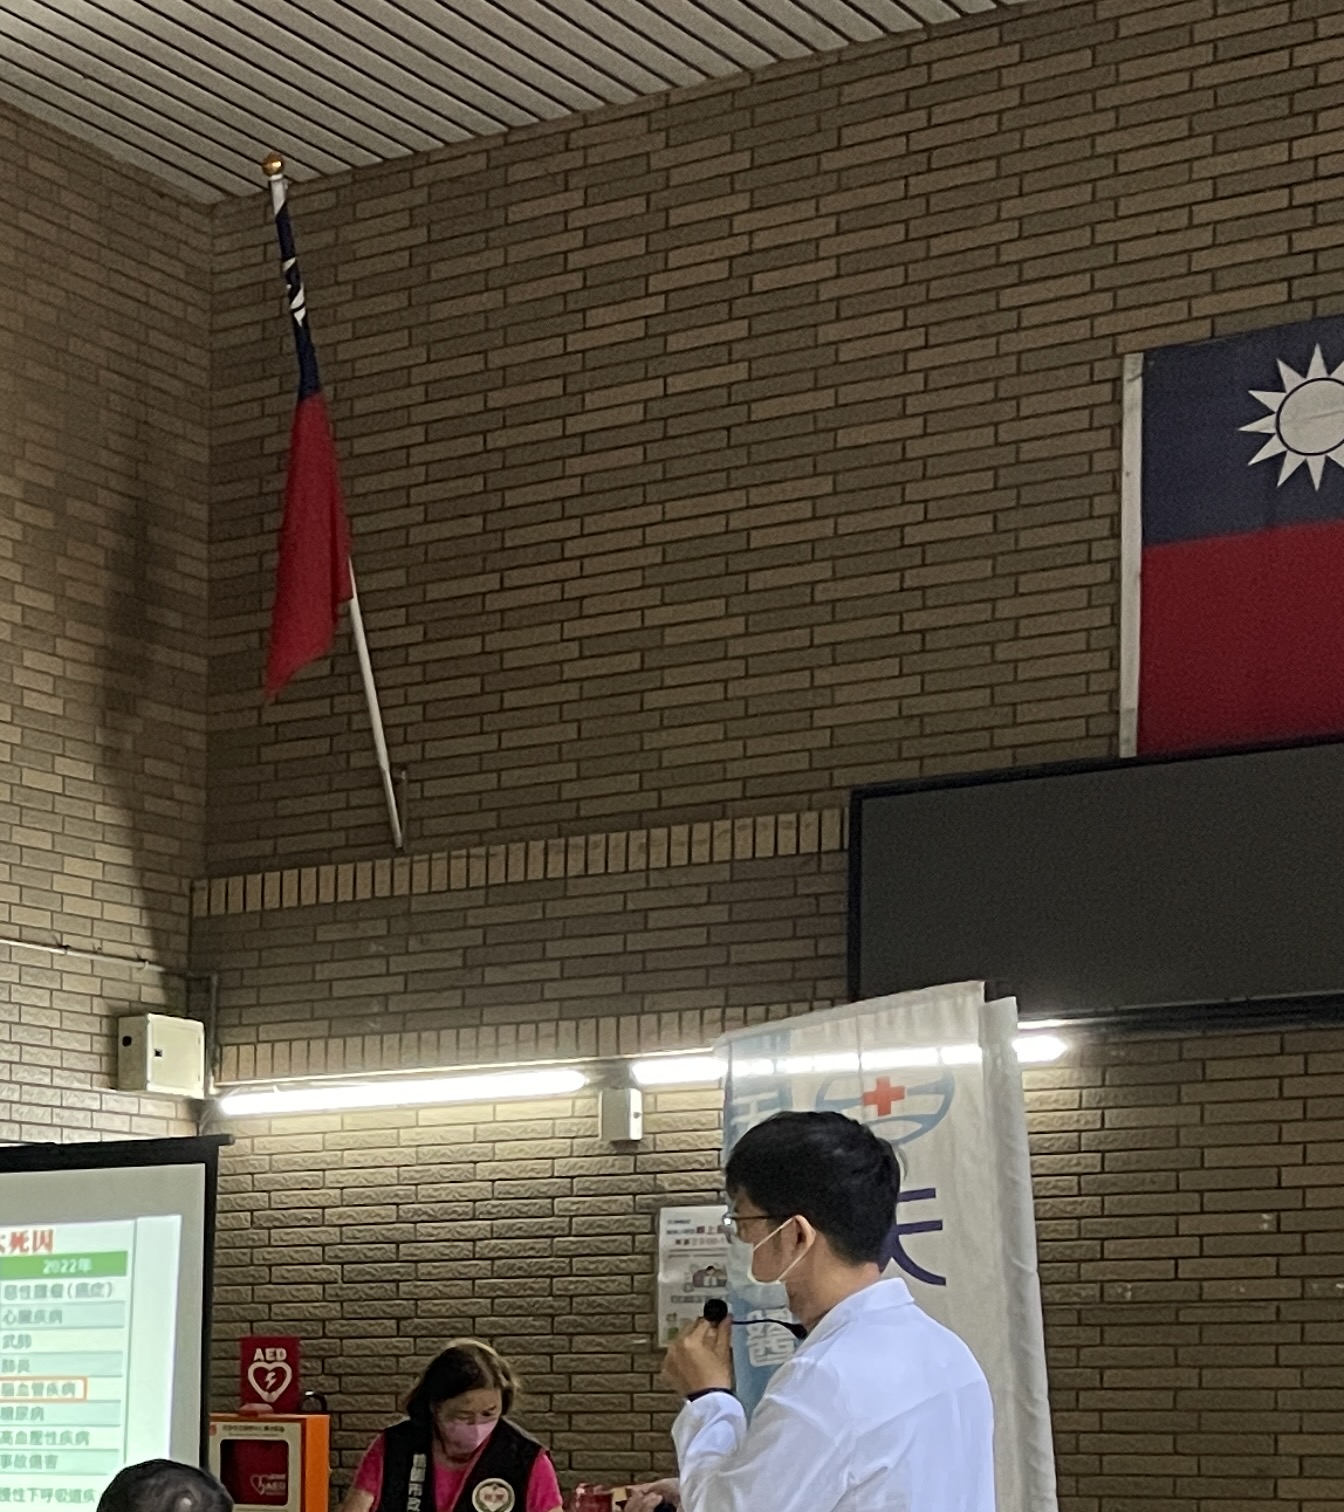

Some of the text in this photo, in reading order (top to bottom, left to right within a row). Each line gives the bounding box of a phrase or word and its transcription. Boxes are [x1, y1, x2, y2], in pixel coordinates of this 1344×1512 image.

[43, 1258, 92, 1274] 2022年
[3, 1310, 63, 1325] 心臟疾病
[254, 1347, 287, 1361] AED
[2, 1359, 30, 1373] 肺炎
[1, 1383, 76, 1397] 腦血管疾病
[0, 1406, 44, 1421] 糖尿病
[0, 1430, 89, 1445] 高血壓性疾病
[0, 1454, 58, 1469] 事故傷害
[0, 1487, 95, 1503] 慢性下呼吸道疾
